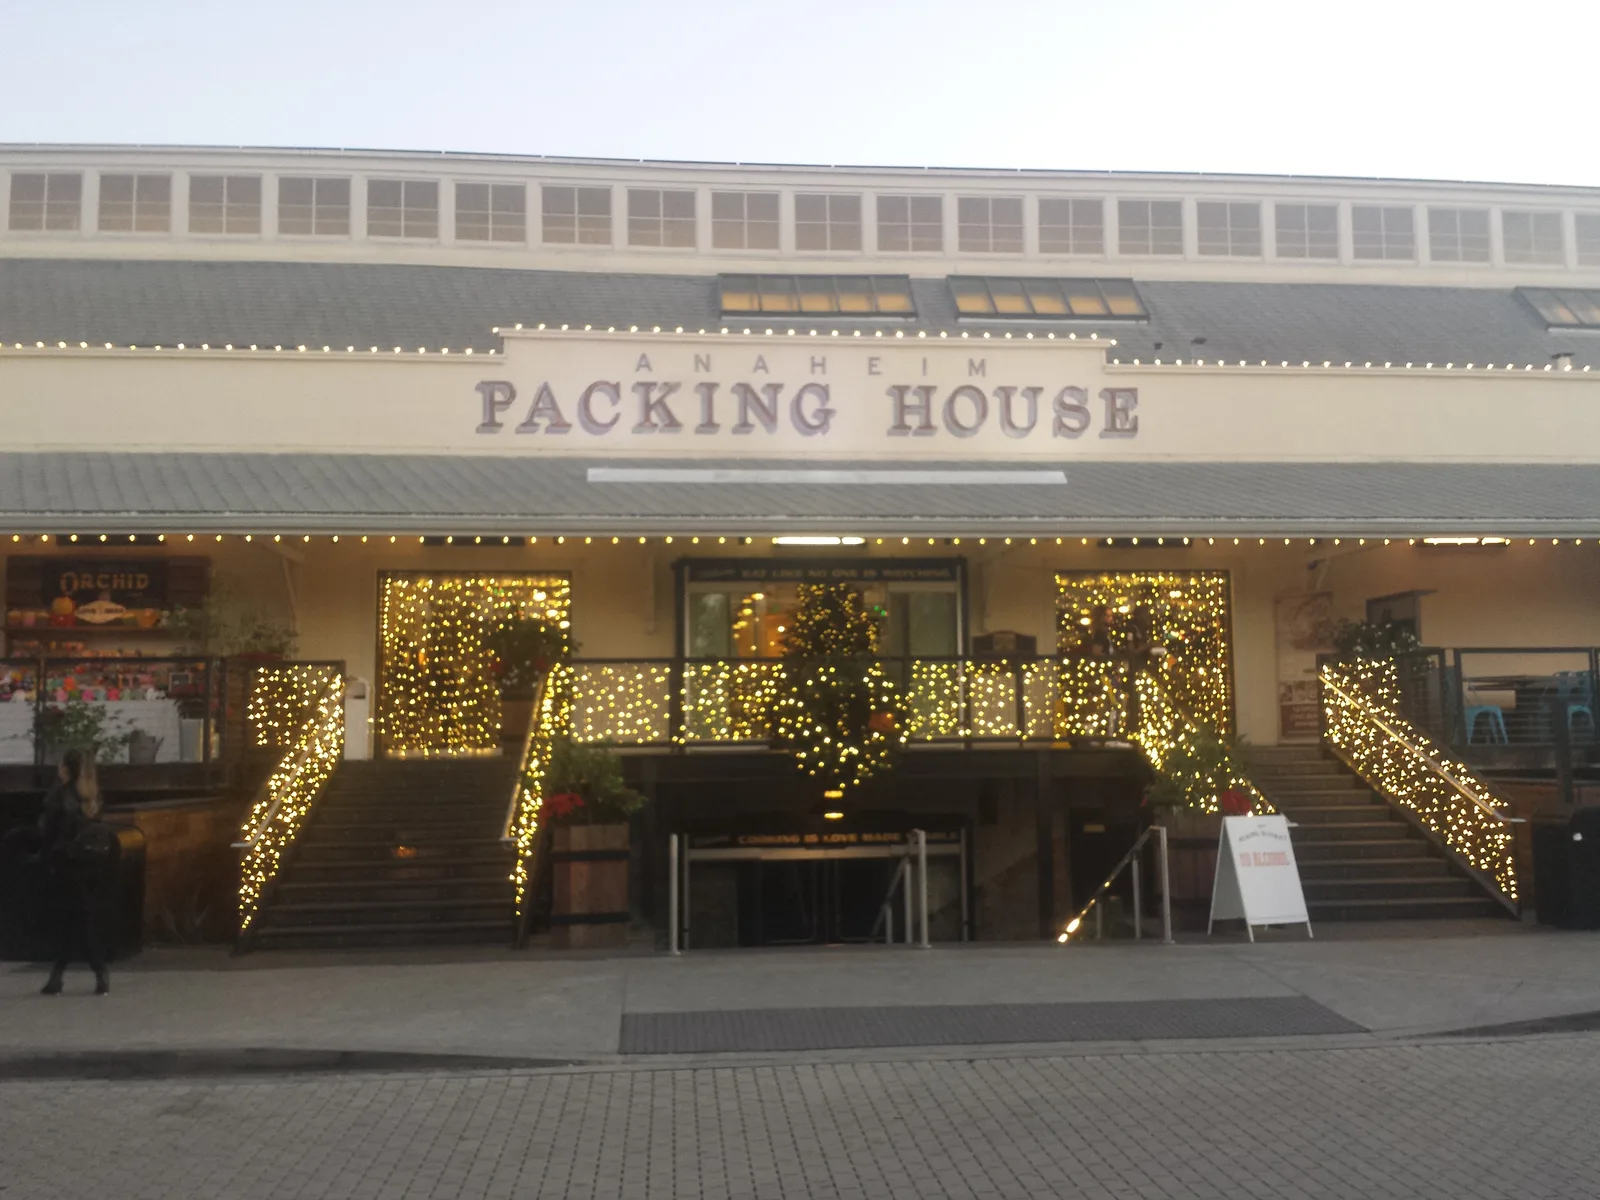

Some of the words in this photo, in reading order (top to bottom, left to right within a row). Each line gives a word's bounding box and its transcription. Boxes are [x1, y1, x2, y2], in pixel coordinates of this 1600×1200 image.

[635, 353, 986, 377] ANAHEIM
[475, 380, 837, 437] PACKING
[886, 384, 1139, 439] HOUSE
[60, 571, 149, 595] ORCHID
[741, 568, 766, 578] EAT
[771, 568, 803, 578] LIKE
[807, 568, 827, 578] NO
[831, 568, 858, 578] ONE
[862, 568, 878, 578] IS
[823, 832, 857, 843] LOVE
